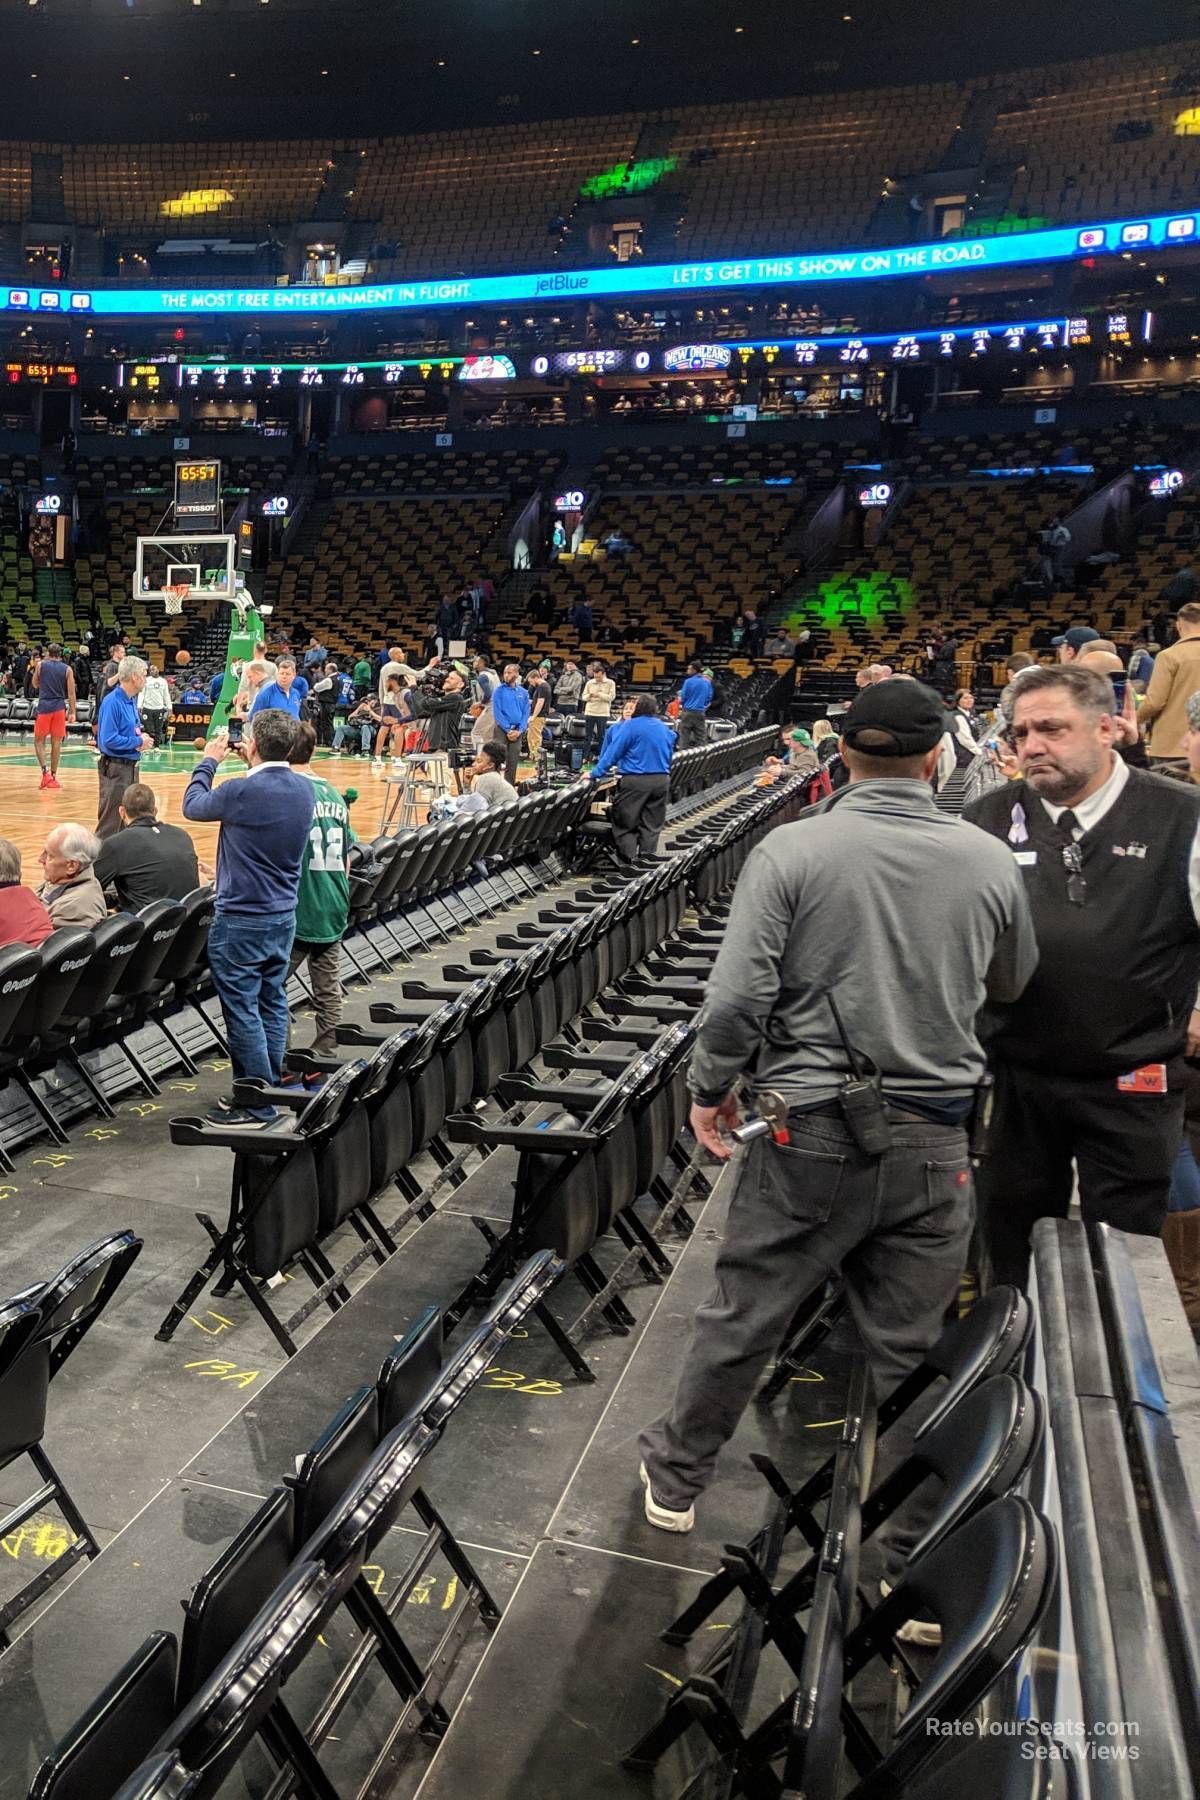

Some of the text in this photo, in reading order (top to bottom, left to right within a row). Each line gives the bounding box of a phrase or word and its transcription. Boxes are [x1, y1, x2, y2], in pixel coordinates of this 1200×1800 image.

[673, 244, 987, 284] LET'S GET THIS SHOW ON THE ROAD.
[535, 275, 589, 296] jetBlue
[161, 283, 471, 307] THE MOST FREE ENTERTAINMENT IN FLIGHT.
[1108, 316, 1127, 325] LAC
[795, 342, 818, 352] FG%
[848, 340, 863, 349] FG
[897, 336, 916, 346] 3PT
[940, 333, 956, 342] TO
[973, 330, 991, 340] STL
[1003, 326, 1026, 337] AST
[1038, 323, 1058, 334] REB
[1070, 327, 1087, 335] DEN
[1071, 332, 1129, 344] 9:00 9:00
[666, 345, 730, 364] NEW ORLEANS
[742, 354, 750, 363] 7
[766, 353, 775, 363] 0
[797, 350, 814, 362] 75
[840, 348, 868, 361] 3/4
[892, 344, 919, 357] 2/2
[975, 338, 986, 351] 1
[1043, 332, 1054, 346] 1
[533, 356, 549, 374] 0
[566, 352, 615, 367] 65:52
[635, 352, 650, 368] 0
[214, 367, 229, 375] AST
[243, 367, 257, 375] STL
[271, 367, 282, 375] TO
[303, 367, 319, 375] 3PT
[347, 365, 358, 374] FG
[384, 363, 404, 372] FG%
[190, 375, 198, 385] 2
[217, 375, 226, 385] 4
[245, 375, 253, 385] 1
[272, 375, 280, 385] 1
[300, 374, 323, 385] 4/4
[343, 373, 365, 385] 4/6
[386, 371, 400, 382] 67
[422, 370, 429, 379] 7
[180, 466, 216, 480] 65:51
[566, 491, 584, 506] 10
[871, 483, 890, 499] 10
[44, 495, 61, 509] 10
[188, 503, 217, 512] TISSOT
[272, 496, 289, 511] 10
[169, 712, 212, 725] GARDE
[308, 826, 346, 871] 12
[10, 973, 38, 992] Putnam
[480, 1366, 564, 1395] 3B
